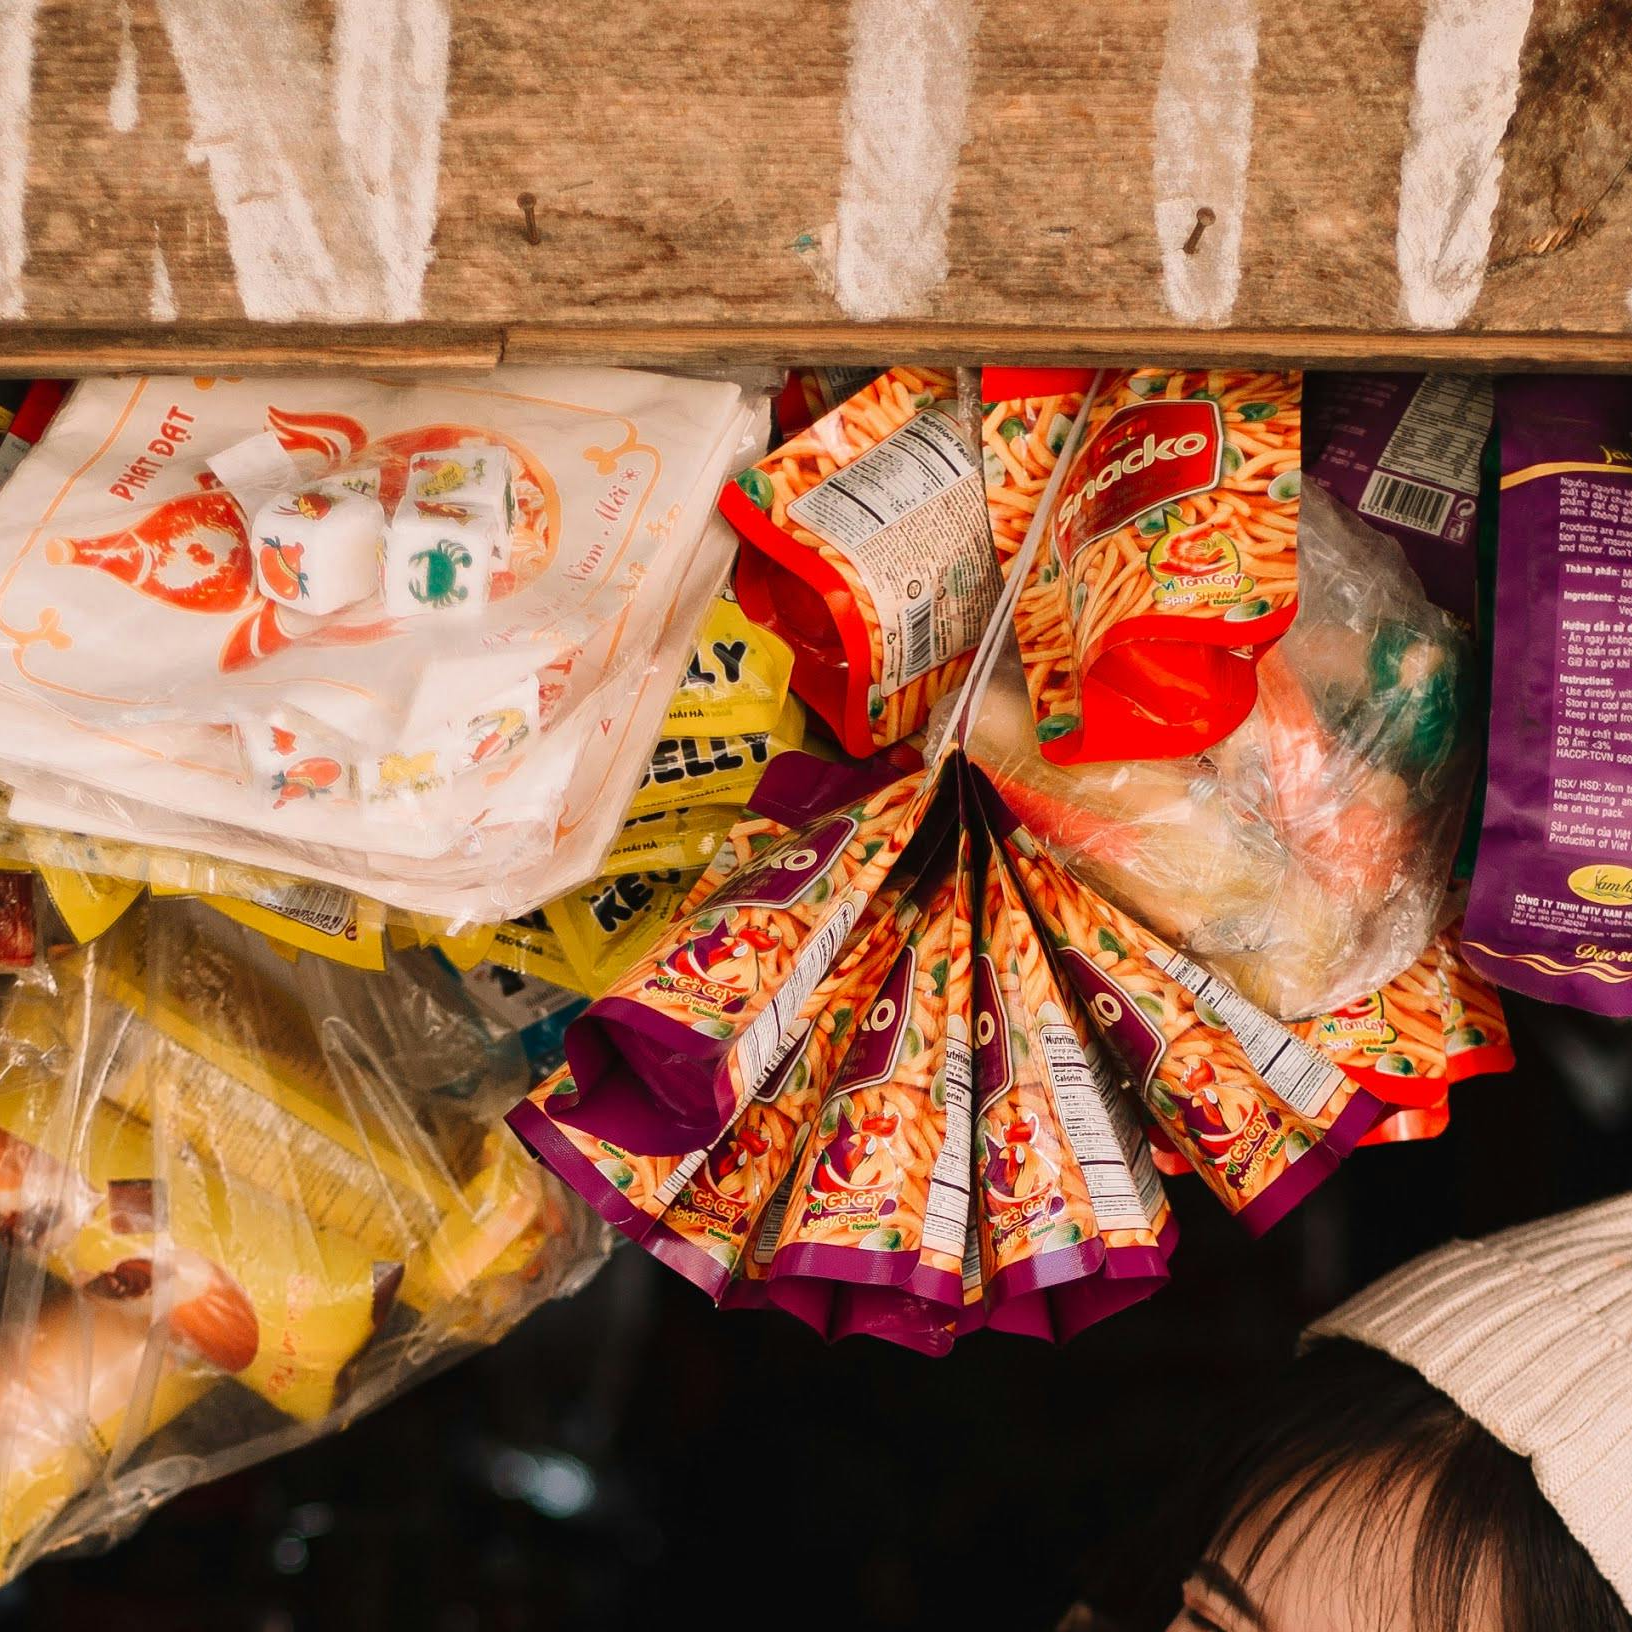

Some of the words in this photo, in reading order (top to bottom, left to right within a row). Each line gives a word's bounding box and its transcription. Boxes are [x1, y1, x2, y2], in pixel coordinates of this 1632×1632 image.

[920, 416, 953, 443] Nutrition
[109, 455, 164, 504] PHÁT
[154, 405, 196, 458] ĐẠT
[1179, 574, 1210, 587] Tôm
[1212, 574, 1243, 588] Cay
[1564, 591, 1615, 602] Ingredients:
[1559, 673, 1614, 686] Instructions:
[1566, 686, 1582, 696] Use
[1584, 688, 1616, 700] directly
[1565, 698, 1589, 708] Store
[1591, 700, 1599, 709] in
[1602, 700, 1619, 710] cool
[1565, 710, 1587, 721] Keep
[1589, 711, 1595, 720] it
[1598, 712, 1617, 723] tight
[639, 733, 768, 790] ELLY
[1556, 749, 1614, 762] HACCP:TCVN
[1555, 779, 1576, 790] NSX/
[1579, 780, 1602, 791] HSD:
[1604, 783, 1623, 793] Xem
[1554, 790, 1616, 806] Manufacturing
[1553, 802, 1568, 812] see
[1571, 805, 1582, 813] on
[1585, 805, 1600, 815] the
[1602, 808, 1625, 819] pack.
[1551, 821, 1568, 832] Sản
[1569, 823, 1595, 837] phẩm
[1596, 826, 1612, 838] của
[1614, 828, 1631, 839] Việt
[1549, 833, 1595, 847] Production
[1598, 840, 1608, 848] of
[1611, 840, 1628, 851] Viet
[1515, 894, 1540, 907] CÔNG
[1542, 899, 1554, 909] TY
[1556, 900, 1580, 913] TNHH
[1581, 904, 1601, 916] MTV
[1603, 908, 1623, 919] NAM
[673, 976, 701, 992] Gà
[702, 984, 735, 1003] Cay
[1361, 1019, 1386, 1034] Cay
[1055, 1074, 1082, 1083] Calories
[825, 1191, 850, 1209] Gà
[852, 1192, 889, 1211] Cay
